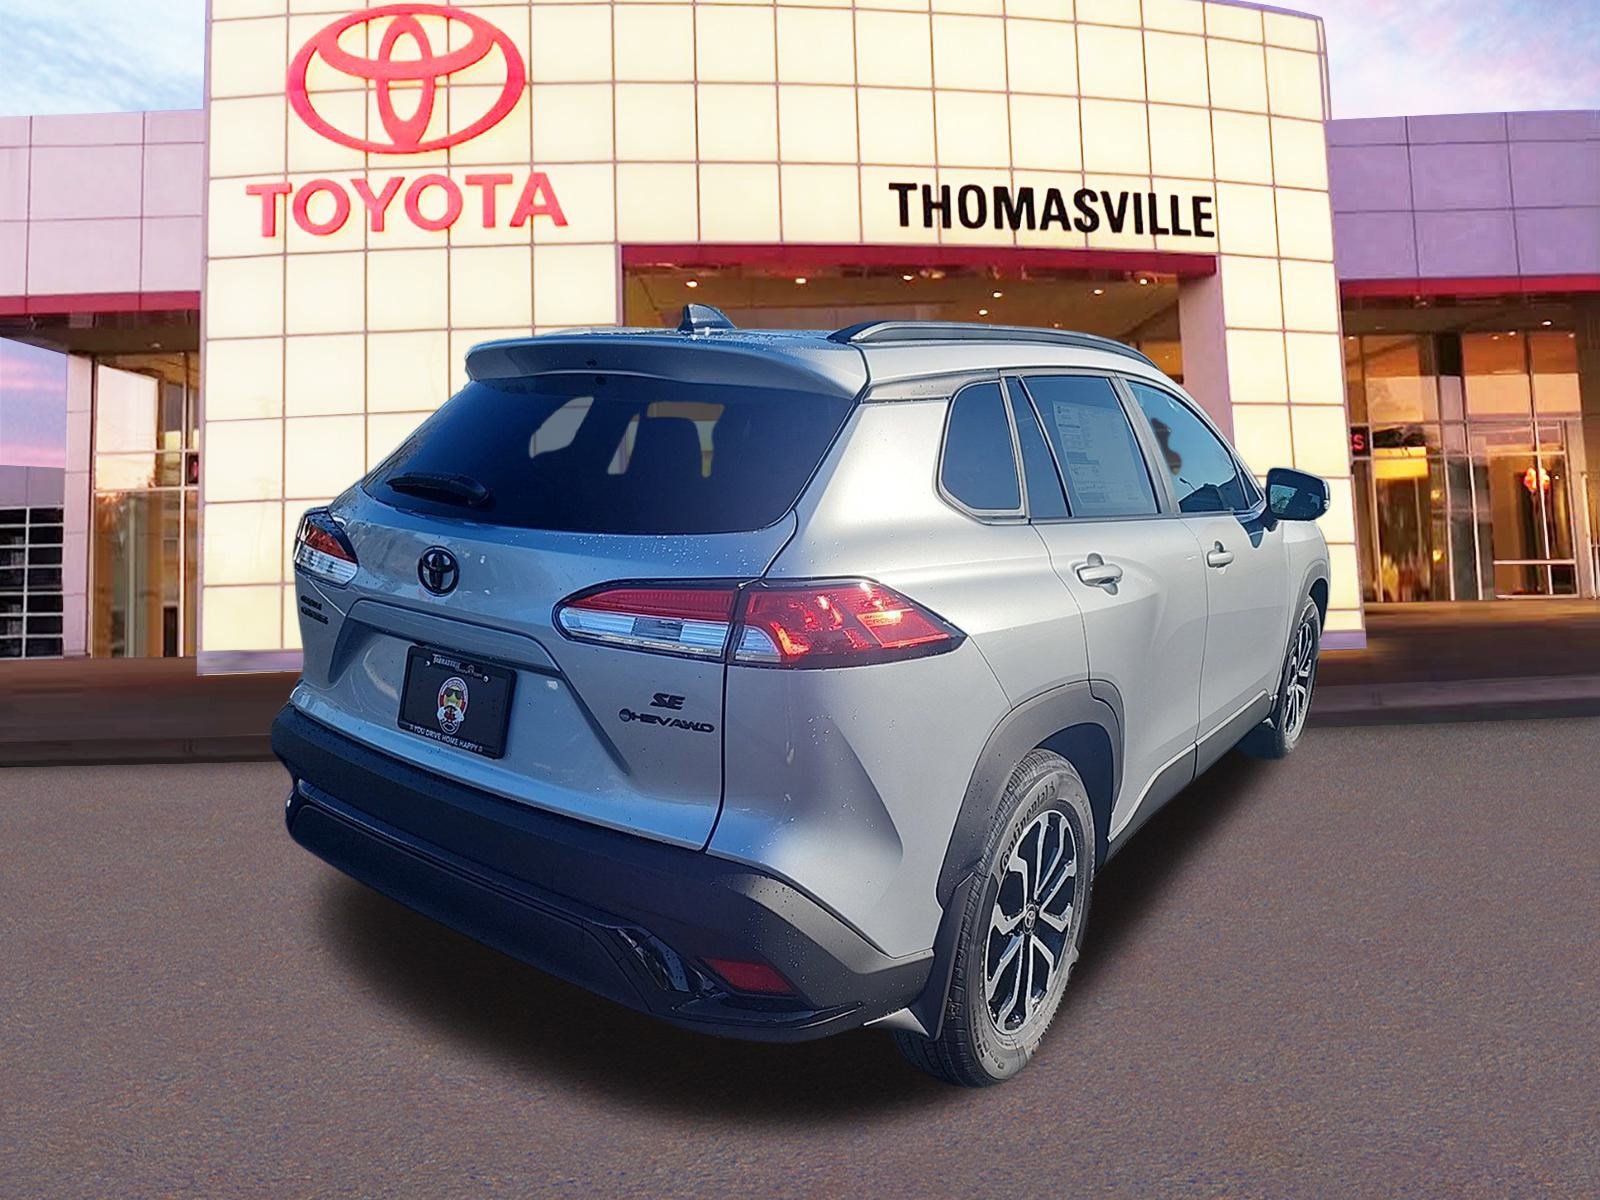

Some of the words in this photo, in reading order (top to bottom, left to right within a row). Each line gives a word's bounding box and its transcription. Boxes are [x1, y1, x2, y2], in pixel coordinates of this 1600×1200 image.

[246, 172, 568, 238] TOYOTA
[889, 182, 1215, 238] THOMASVILLE
[650, 692, 686, 710] SE
[414, 725, 426, 735] YOU
[999, 783, 1049, 876] Continental
